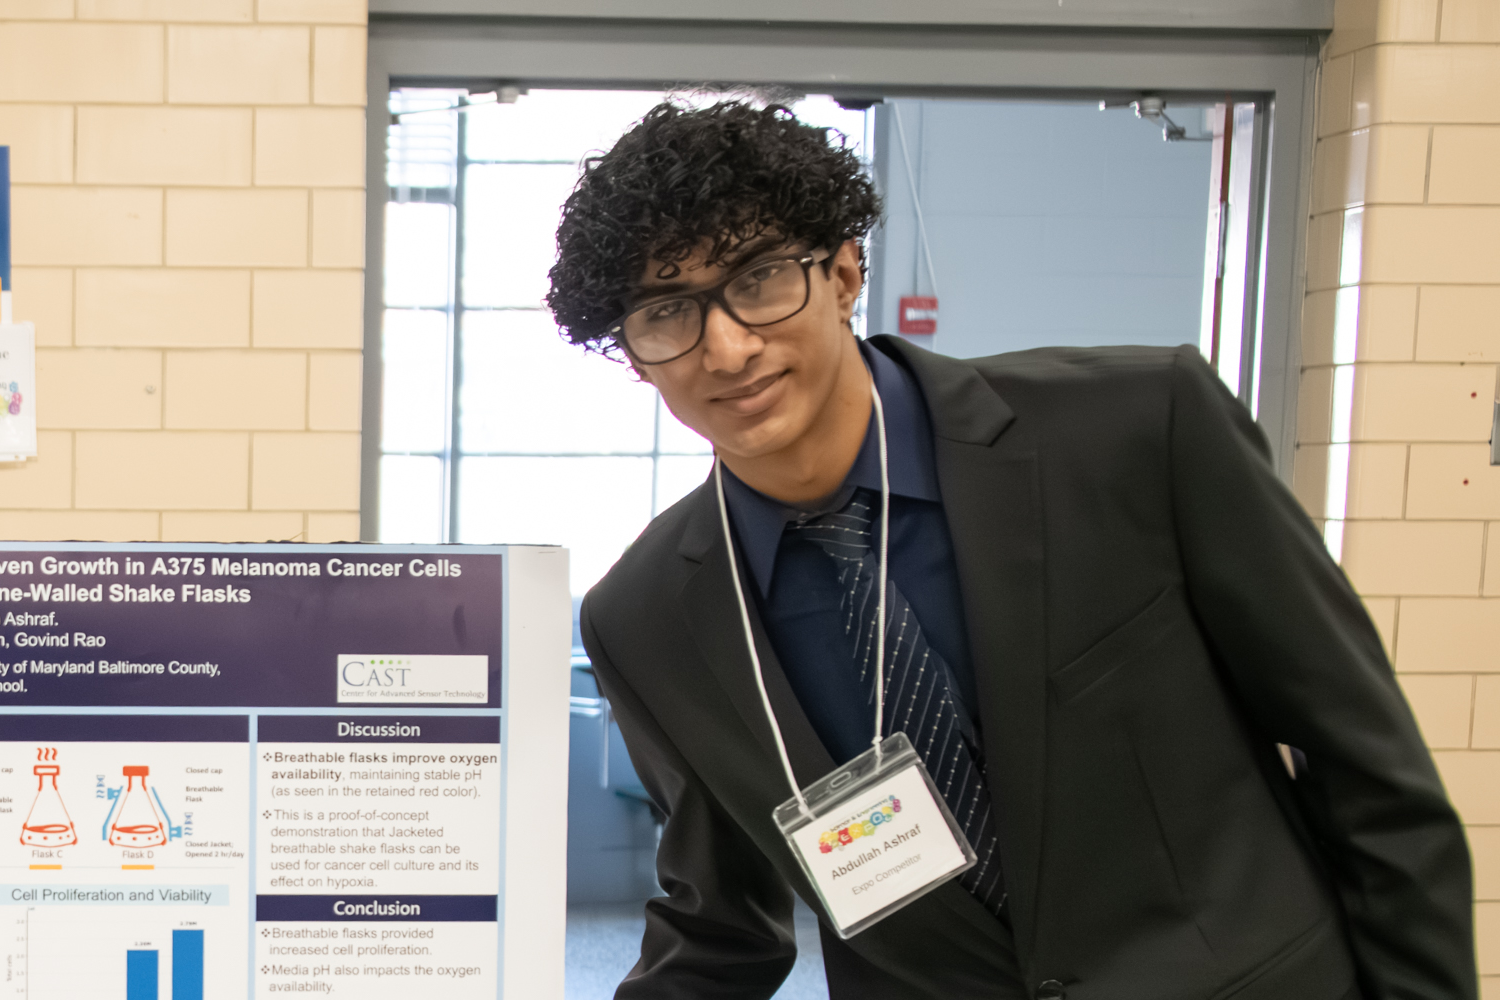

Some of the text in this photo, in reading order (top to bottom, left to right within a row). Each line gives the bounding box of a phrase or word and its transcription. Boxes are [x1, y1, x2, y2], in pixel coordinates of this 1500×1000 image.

[39, 555, 119, 576] Growth
[124, 556, 145, 576] in
[150, 556, 206, 576] A375
[211, 557, 321, 577] Melanoma
[326, 558, 404, 577] Cancer
[408, 558, 463, 578] Cells
[108, 583, 176, 603] Shake
[181, 583, 252, 603] Flasks
[3, 611, 59, 627] Ashraf.
[14, 631, 69, 648] Govind
[73, 631, 106, 648] Rao
[12, 659, 29, 674] of
[30, 659, 95, 678] Maryland
[98, 659, 165, 675] Baltimore
[167, 660, 221, 678] County,
[343, 661, 411, 687] CAST
[444, 690, 485, 698] Technology
[337, 721, 421, 737] Discussion
[274, 751, 498, 765] Breathable flasks improve oxygen
[271, 768, 482, 783] availability, maintaining stable pH
[32, 850, 63, 858] Flask C
[122, 851, 154, 859] Flask D
[831, 824, 921, 880] Abdullah Ashraf
[852, 853, 922, 896] Expo Competitor
[10, 888, 213, 905] Cell Proliferation and Viability
[332, 899, 421, 916] Conclusion
